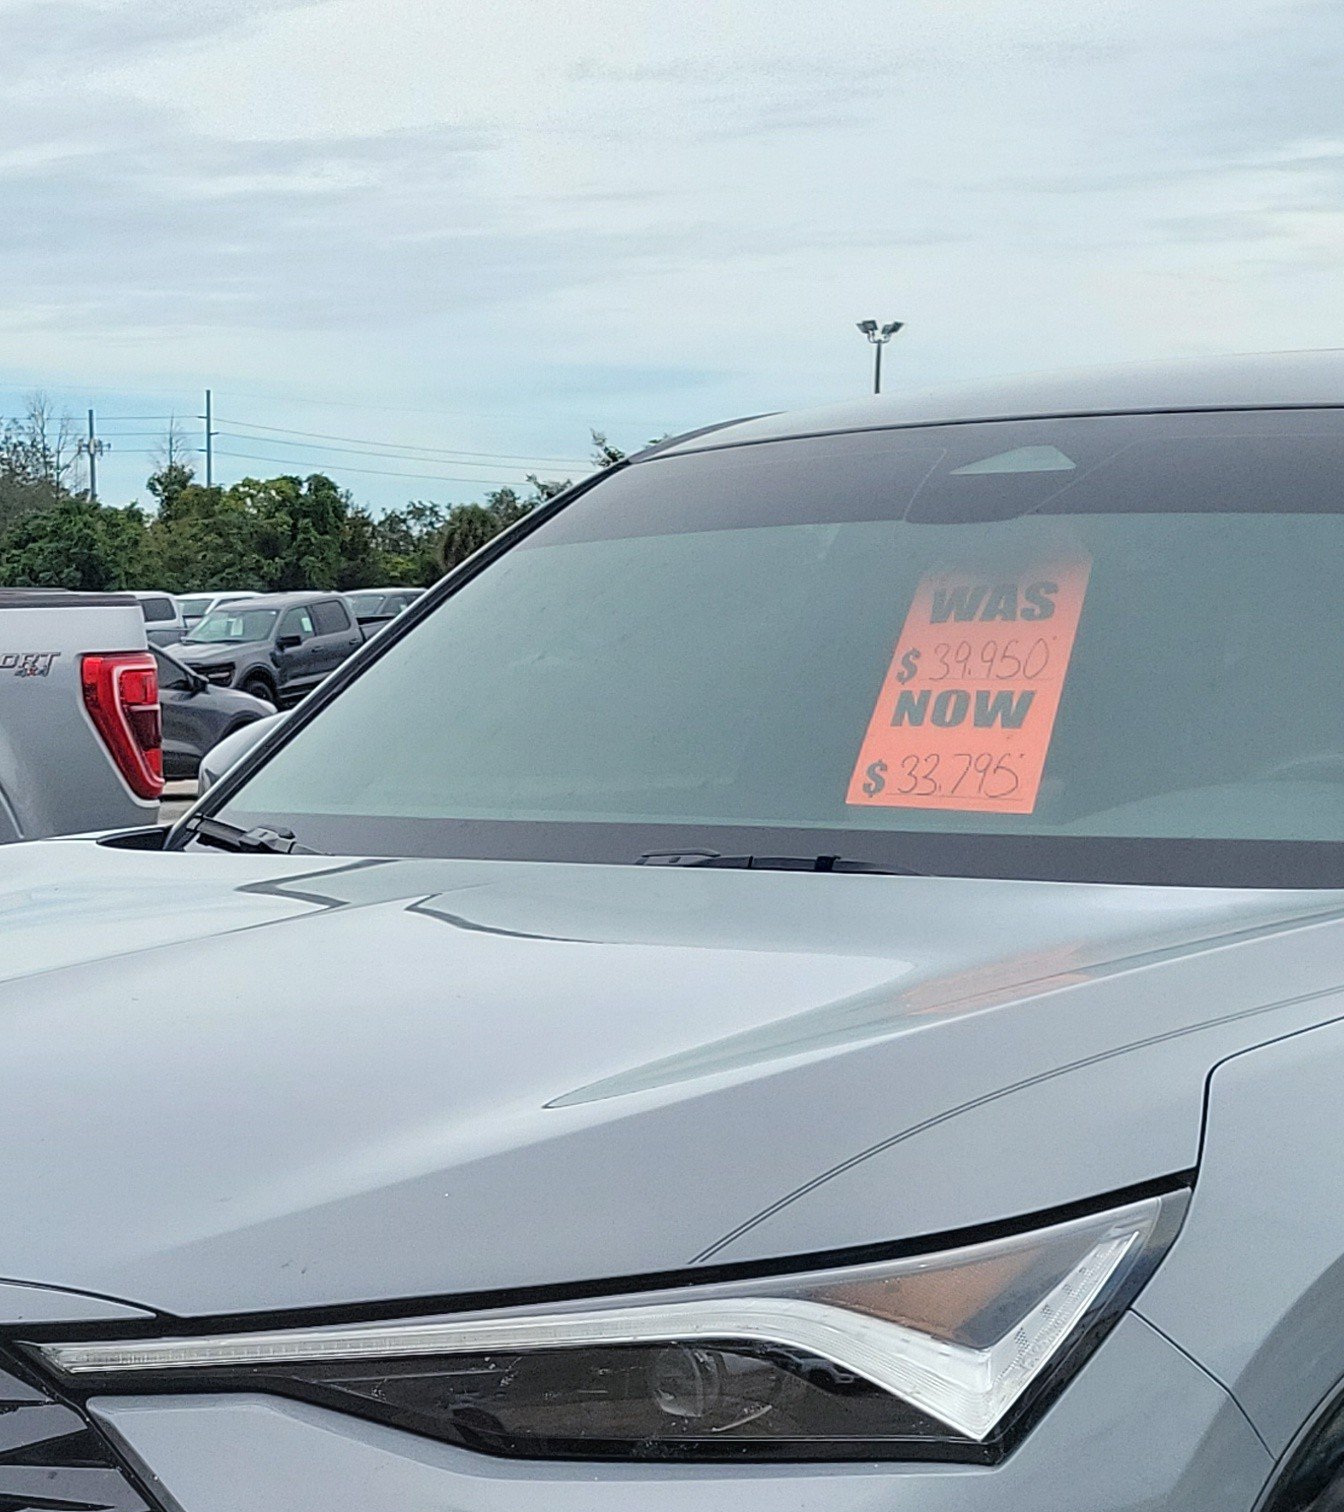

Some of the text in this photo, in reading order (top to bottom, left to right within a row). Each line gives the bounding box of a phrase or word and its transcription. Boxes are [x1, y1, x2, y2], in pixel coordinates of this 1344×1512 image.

[930, 581, 1058, 624] WAS
[895, 647, 922, 685] $
[890, 690, 1037, 729] NOW
[862, 759, 888, 799] $
